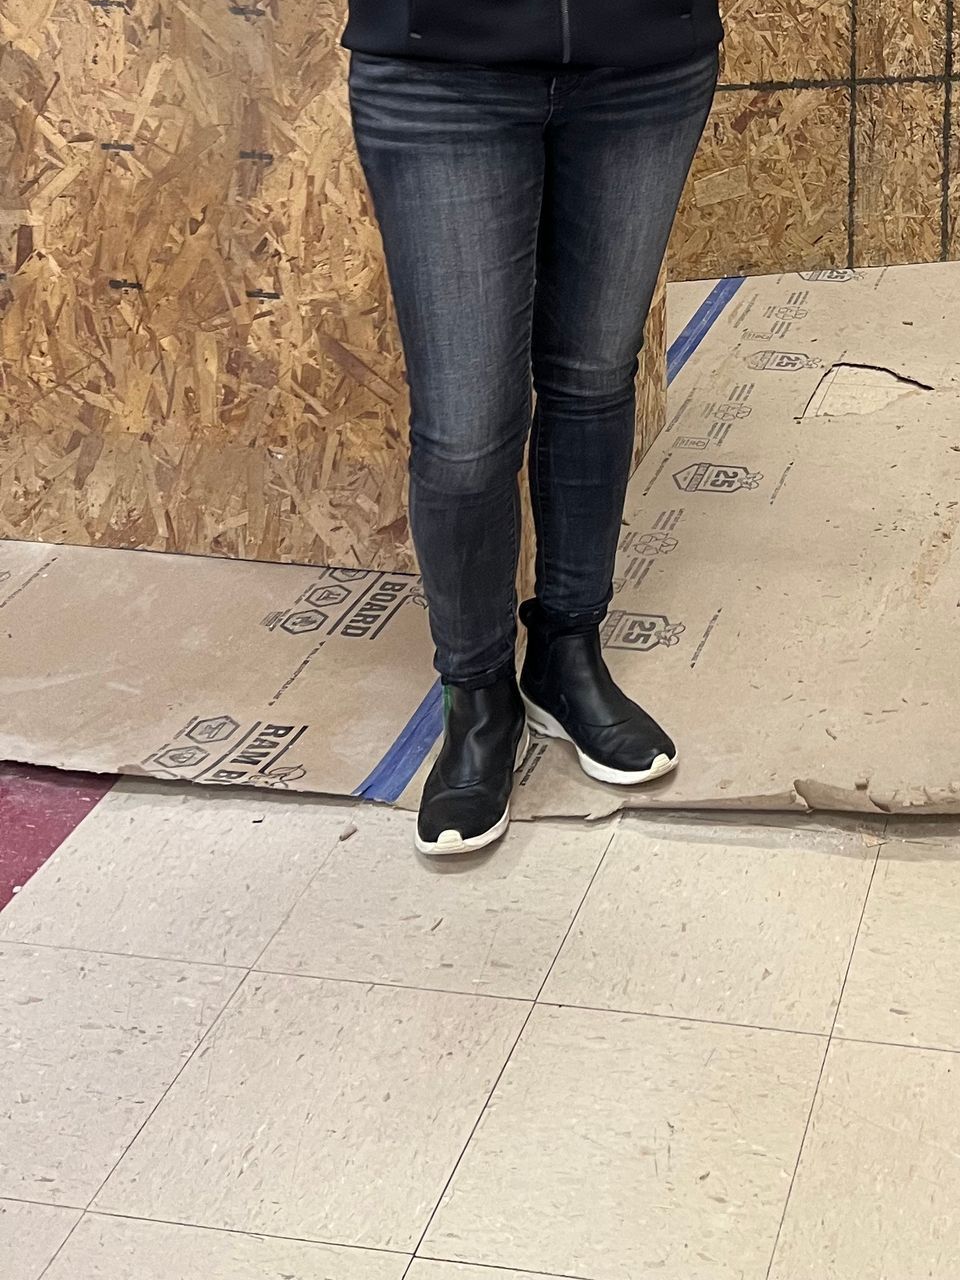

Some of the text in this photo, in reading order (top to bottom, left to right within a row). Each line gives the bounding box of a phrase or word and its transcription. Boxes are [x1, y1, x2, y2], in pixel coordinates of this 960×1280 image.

[775, 354, 801, 368] 25
[709, 469, 739, 489] 25
[340, 581, 409, 637] BOARD
[622, 619, 656, 645] 25
[230, 723, 295, 766] RAM
